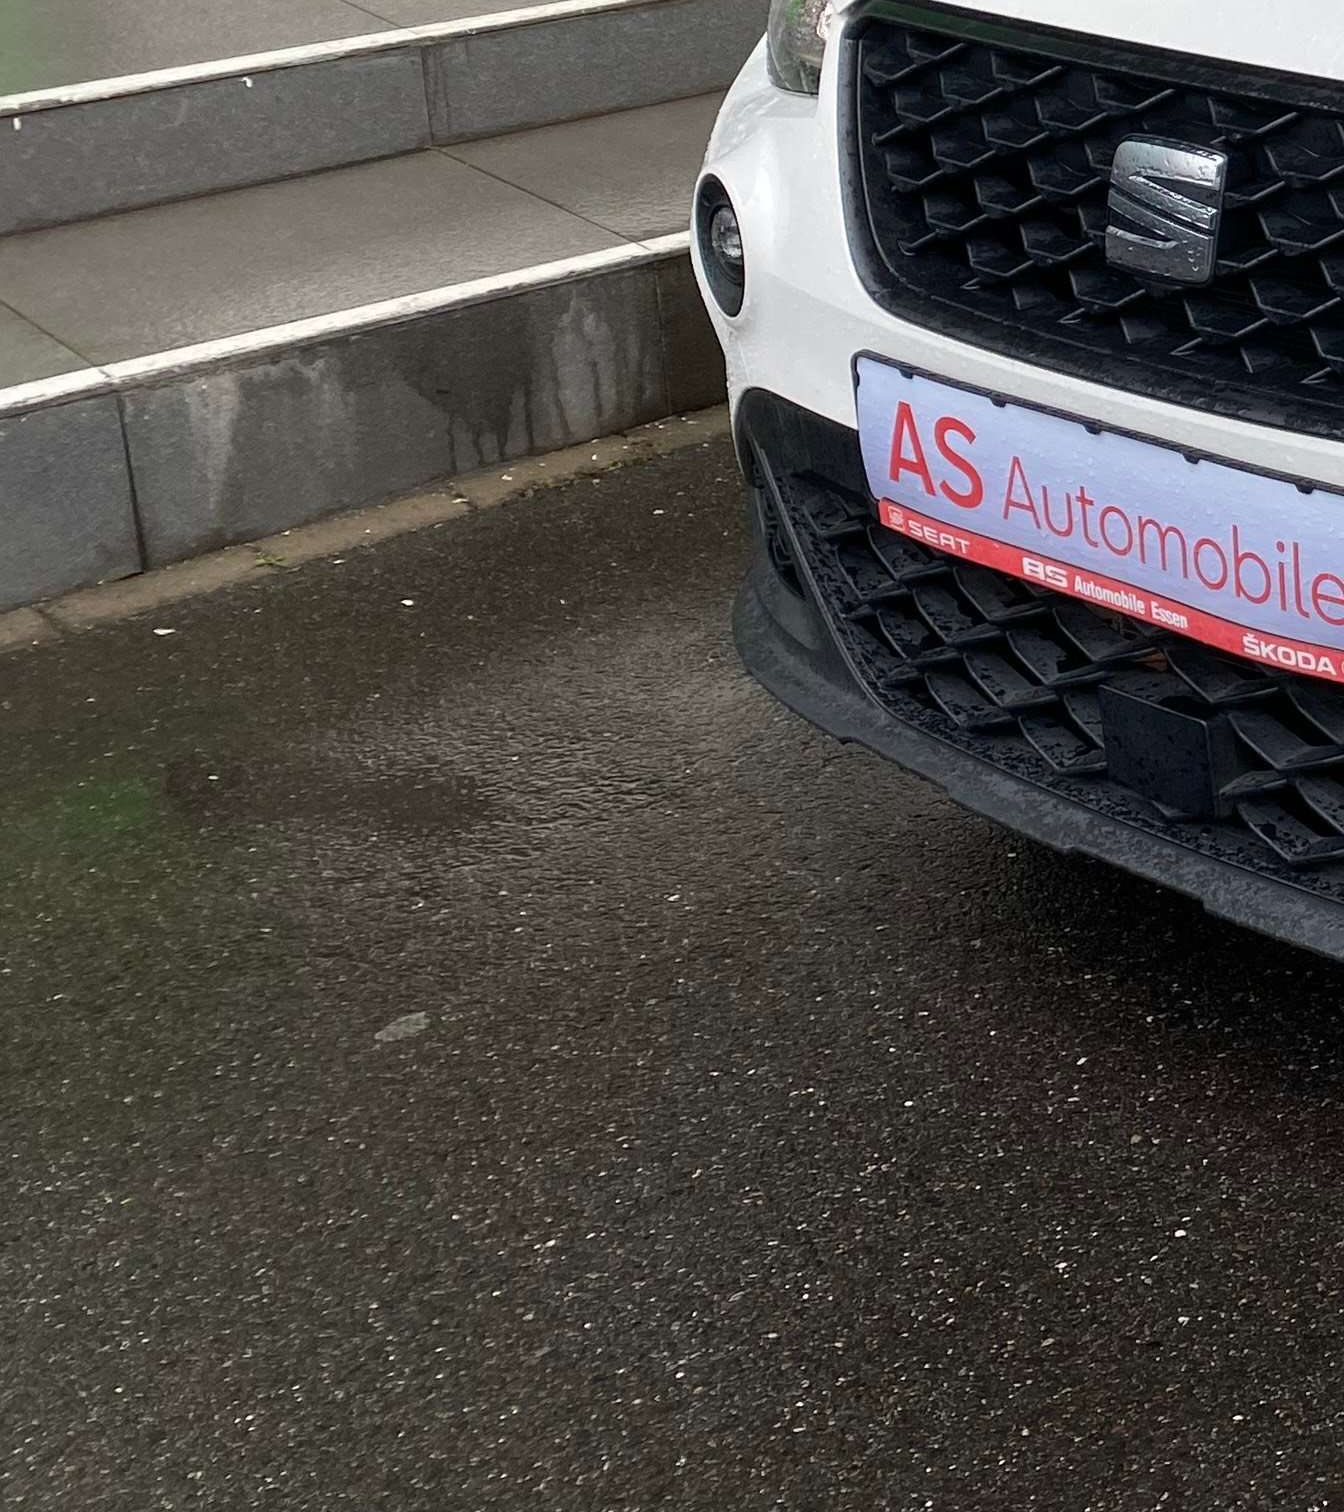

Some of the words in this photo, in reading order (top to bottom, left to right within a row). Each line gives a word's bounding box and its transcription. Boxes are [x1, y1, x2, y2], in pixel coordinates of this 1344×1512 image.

[888, 400, 984, 509] AS
[907, 519, 971, 554] SEAT
[1074, 575, 1146, 615] Automobile
[1151, 600, 1189, 630] Essen
[1242, 632, 1338, 676] ŠKODA
